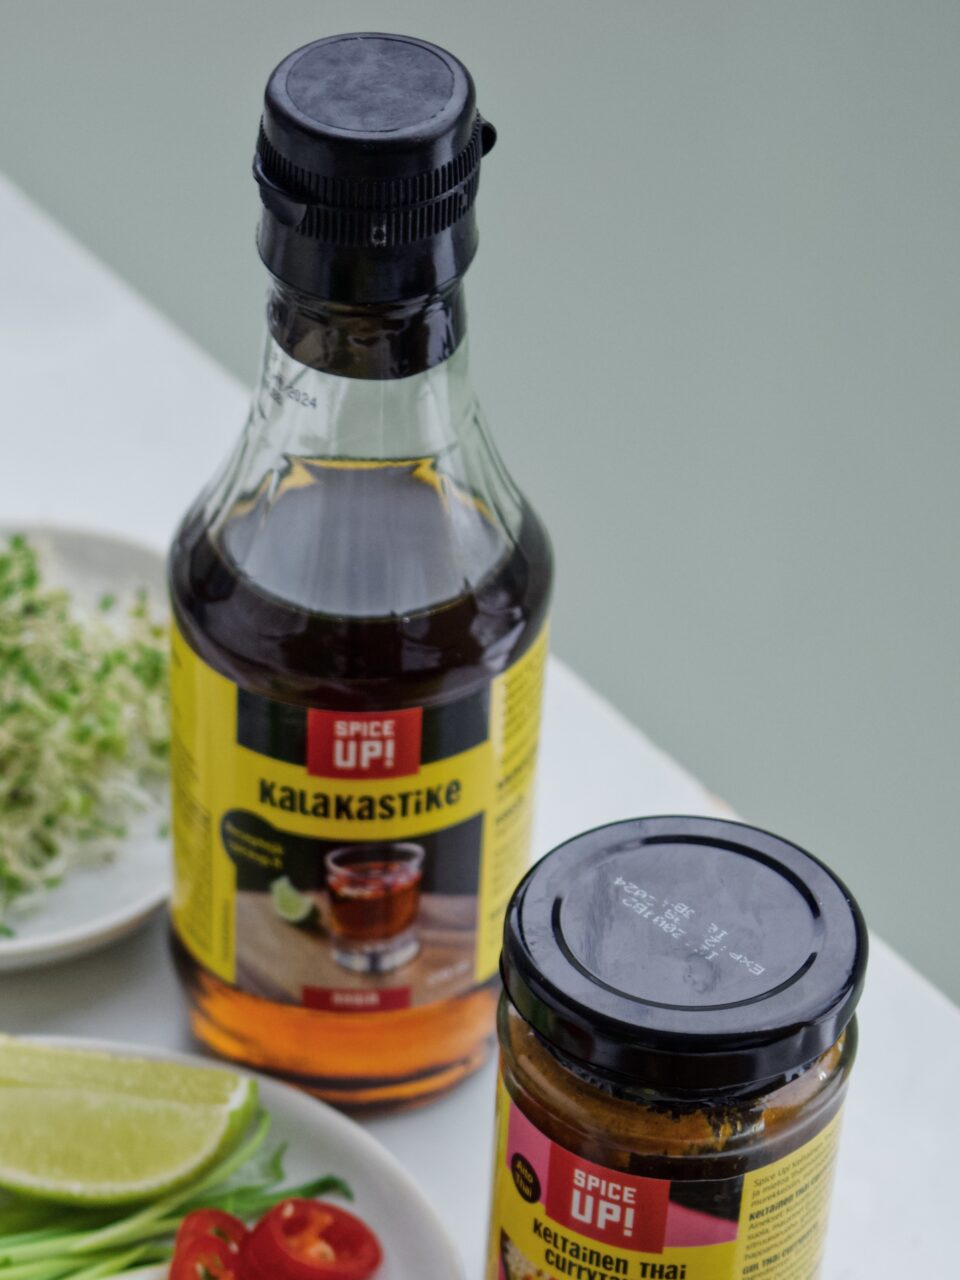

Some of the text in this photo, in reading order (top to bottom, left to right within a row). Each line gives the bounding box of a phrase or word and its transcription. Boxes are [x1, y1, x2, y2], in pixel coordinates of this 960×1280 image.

[333, 720, 395, 737] SPICE
[333, 740, 395, 769] UP!
[573, 1168, 638, 1204] SPICE
[570, 1188, 635, 1238] UP!
